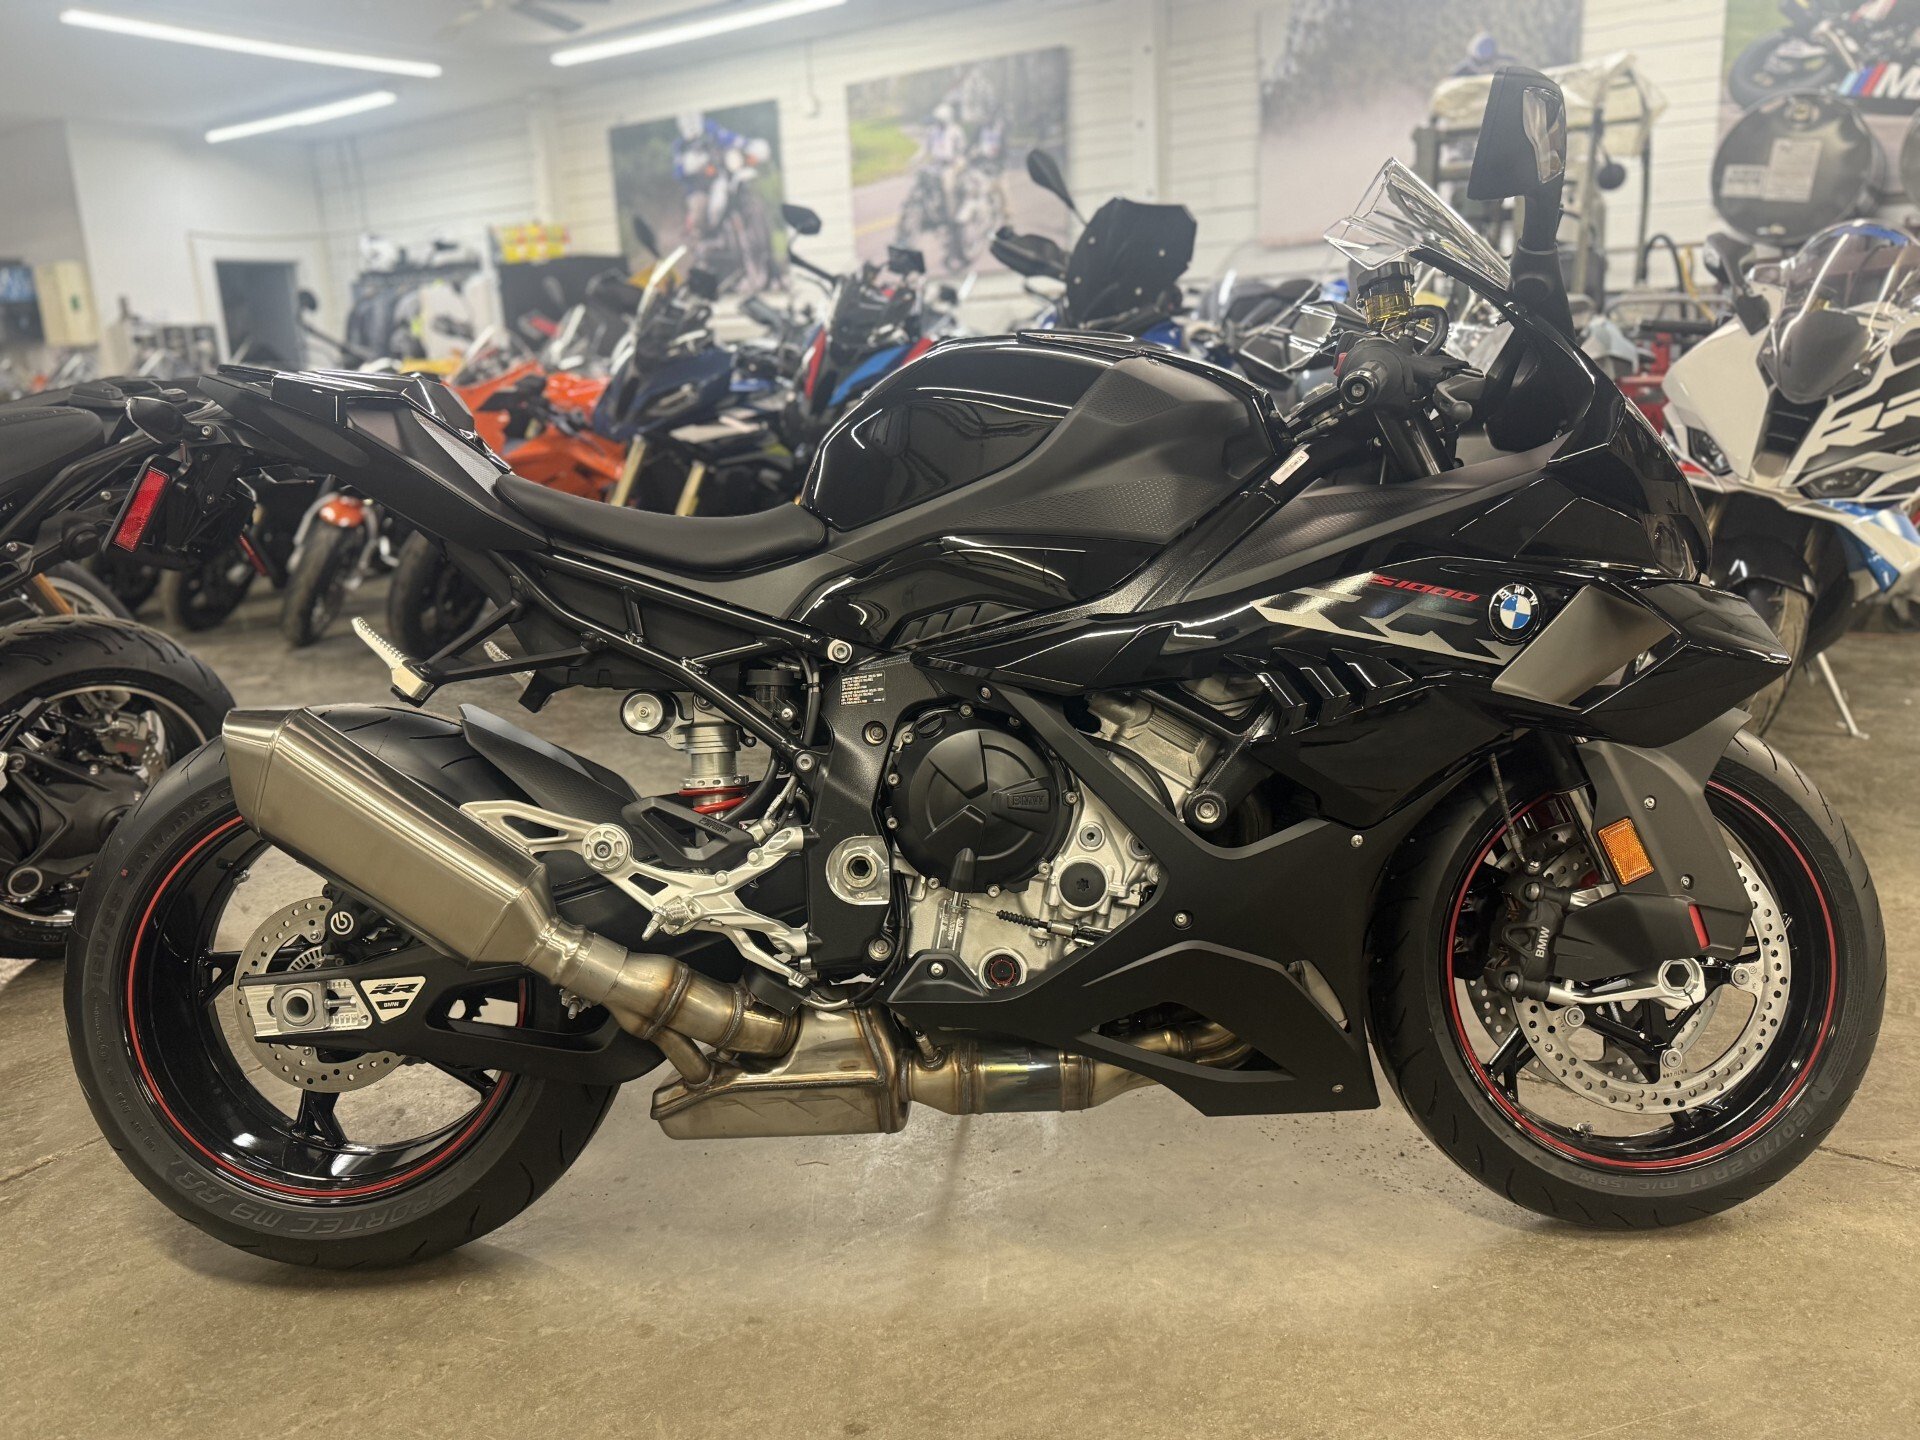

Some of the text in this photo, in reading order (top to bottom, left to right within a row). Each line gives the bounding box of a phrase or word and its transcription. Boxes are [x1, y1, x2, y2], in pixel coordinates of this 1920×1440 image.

[1369, 574, 1481, 602] S1000
[1498, 584, 1540, 606] BMW
[1012, 794, 1045, 806] BMW
[1534, 926, 1551, 959] BMW
[369, 982, 420, 995] RR
[174, 1170, 227, 1203] RR
[289, 1175, 459, 1235] SPORTEC
